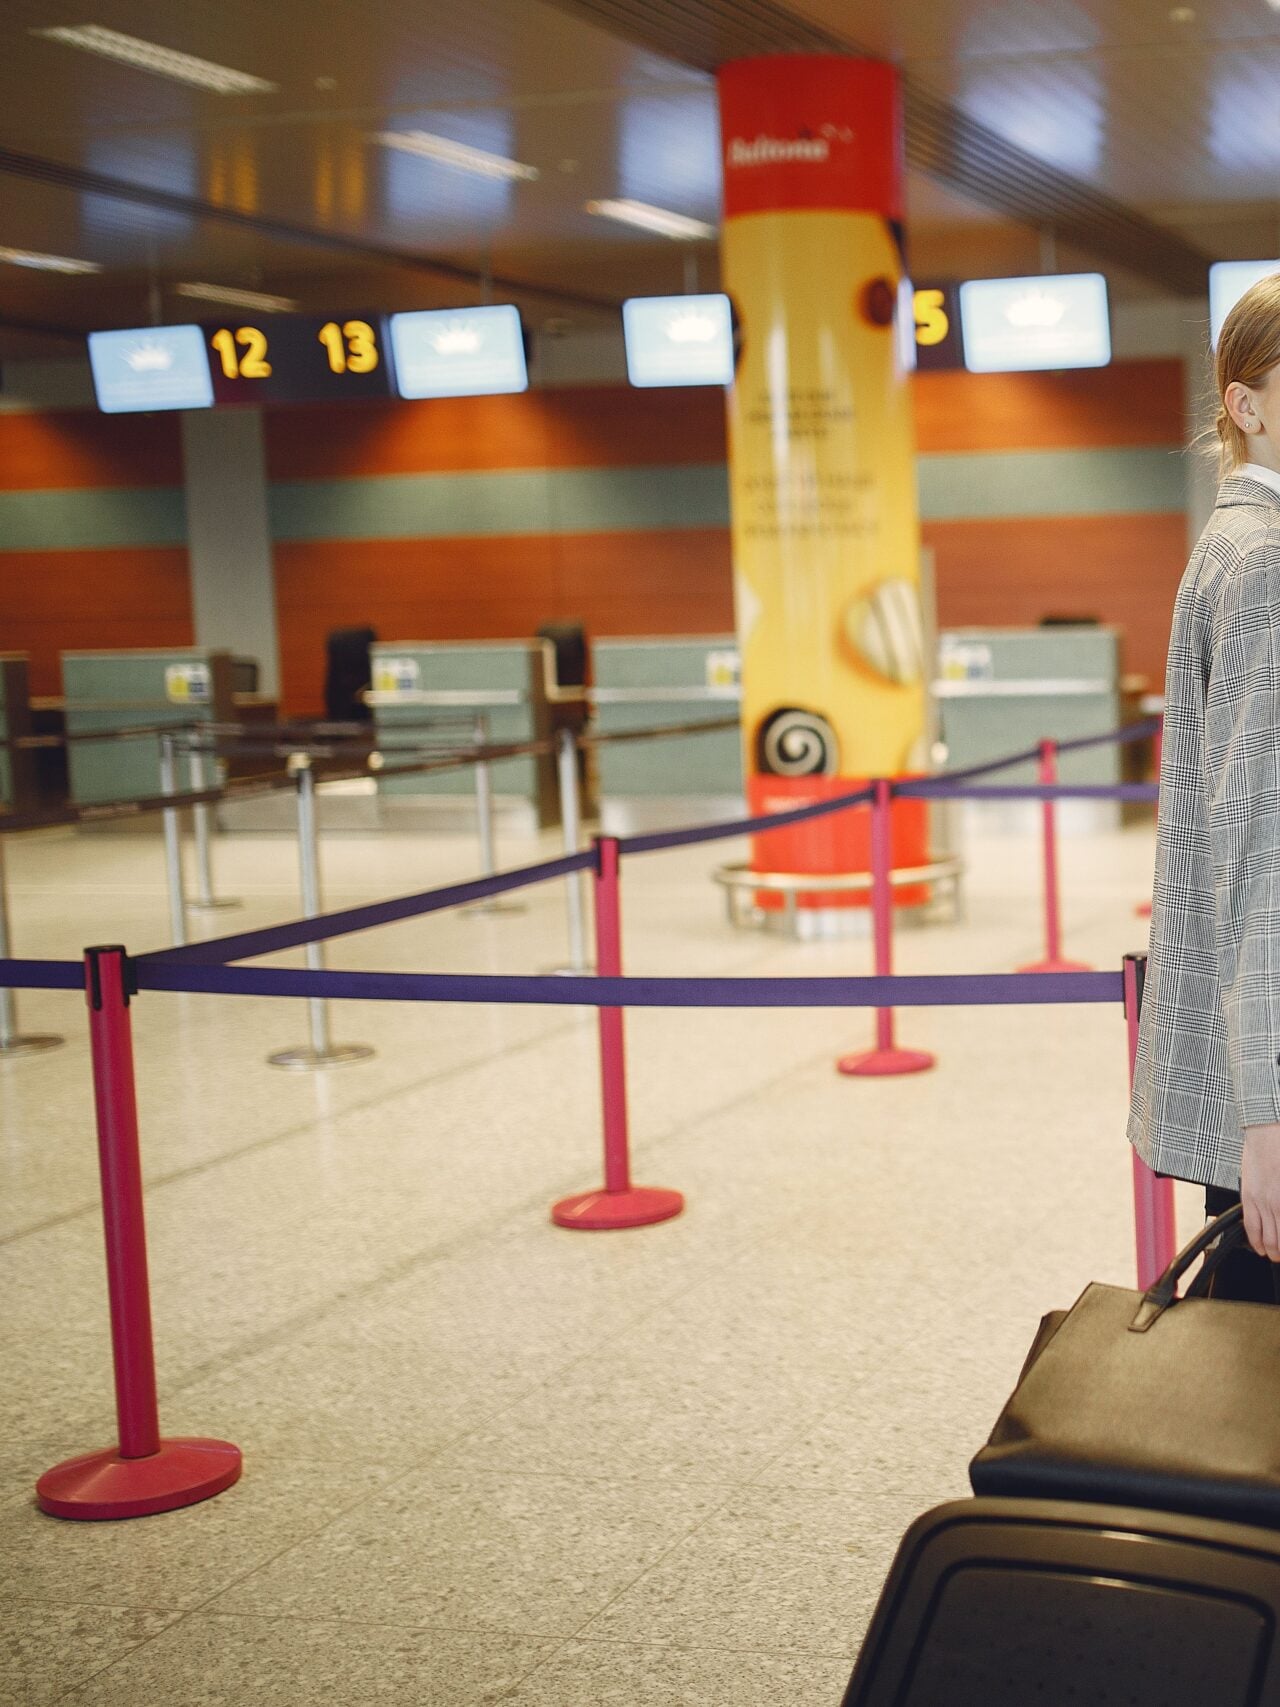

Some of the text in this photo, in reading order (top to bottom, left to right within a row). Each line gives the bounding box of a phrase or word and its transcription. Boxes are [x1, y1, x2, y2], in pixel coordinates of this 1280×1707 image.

[913, 288, 950, 346] 5
[211, 326, 272, 380] 12
[318, 319, 379, 374] 13
